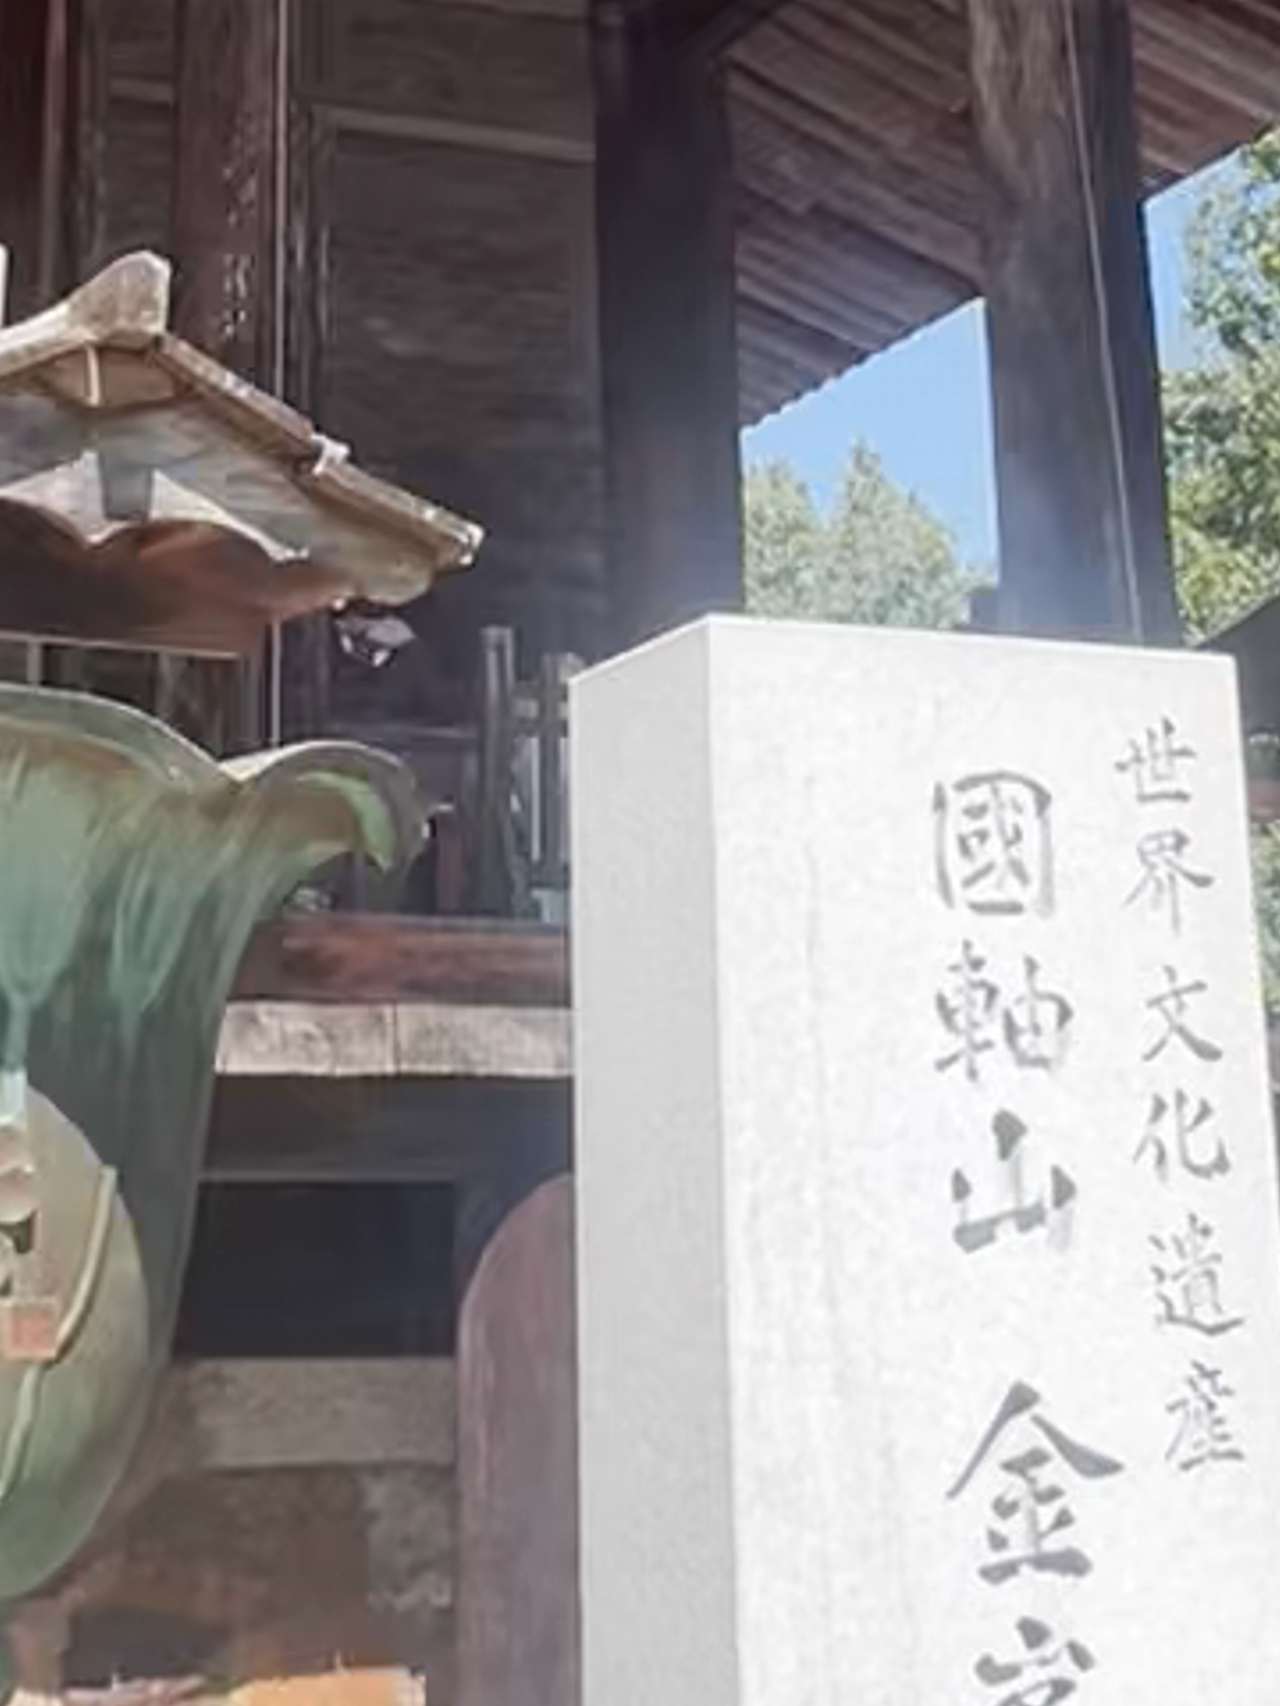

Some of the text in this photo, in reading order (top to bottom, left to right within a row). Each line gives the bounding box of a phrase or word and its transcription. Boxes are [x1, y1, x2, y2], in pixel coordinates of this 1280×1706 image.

[1114, 716, 1248, 1473] 世界文化遺産
